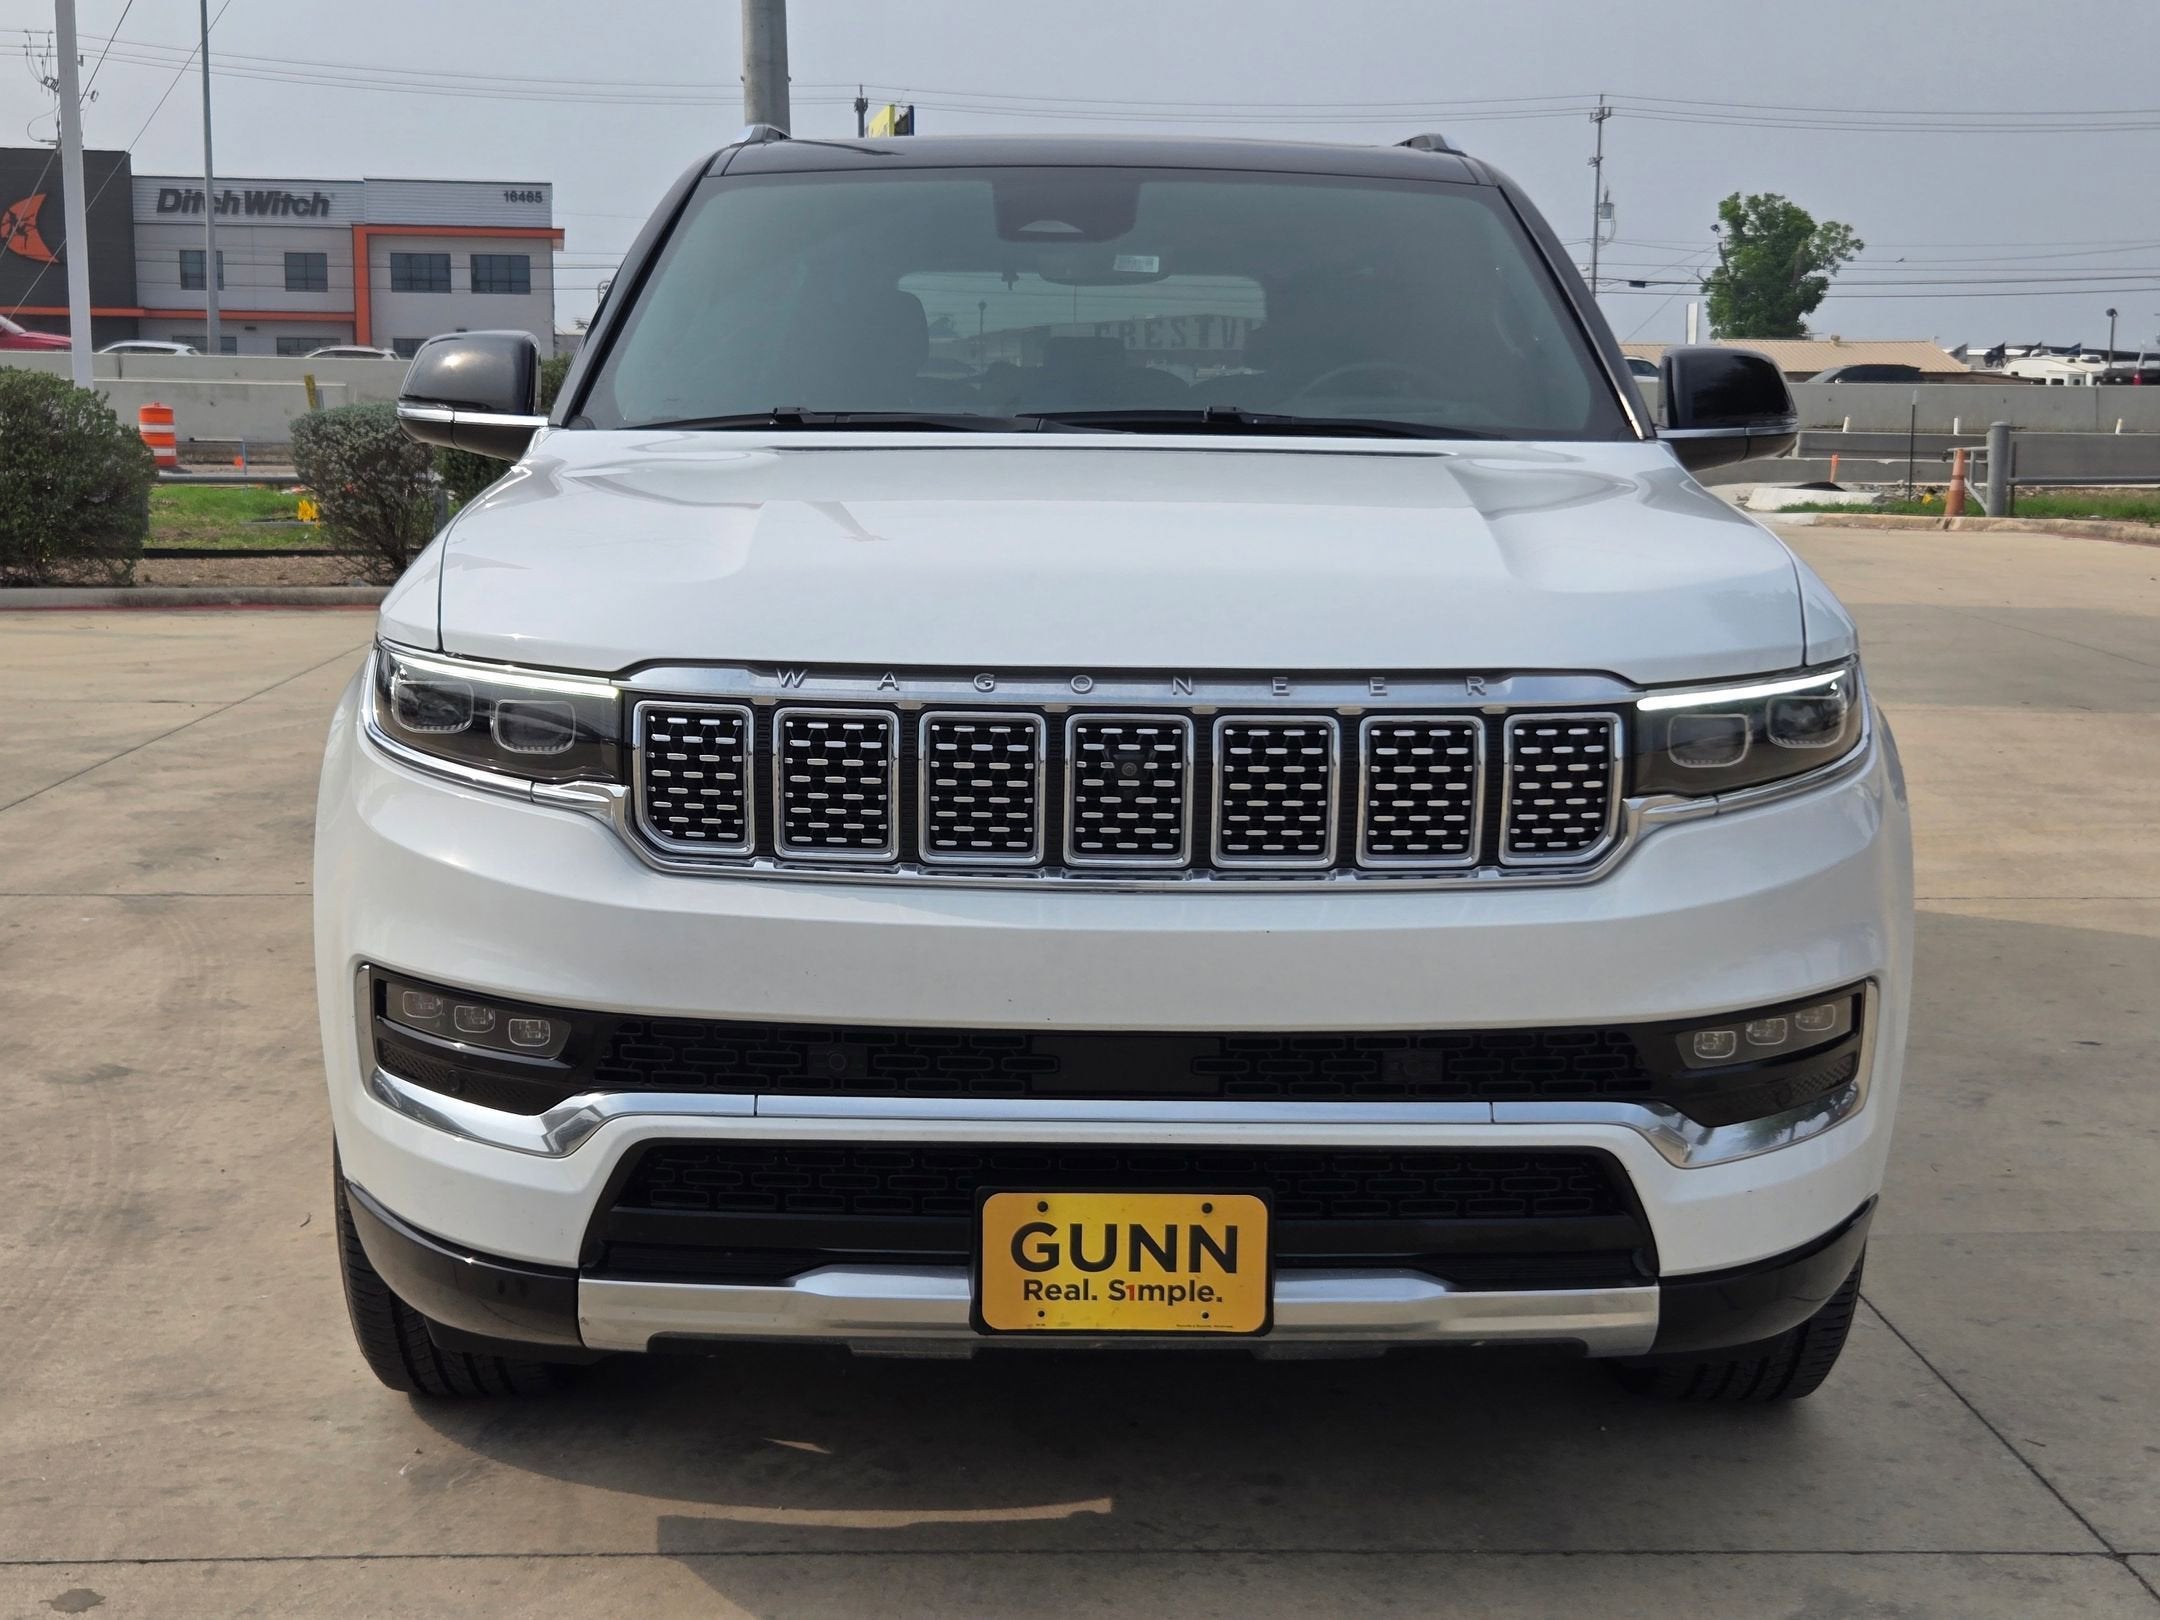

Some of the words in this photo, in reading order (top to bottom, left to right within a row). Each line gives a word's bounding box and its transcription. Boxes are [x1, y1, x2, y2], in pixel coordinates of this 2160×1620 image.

[156, 188, 240, 216] Ditch
[244, 190, 330, 217] Witch
[776, 667, 1487, 697] WAGONEER
[1010, 1221, 1238, 1274] GUNN
[1023, 1278, 1098, 1301] Real.
